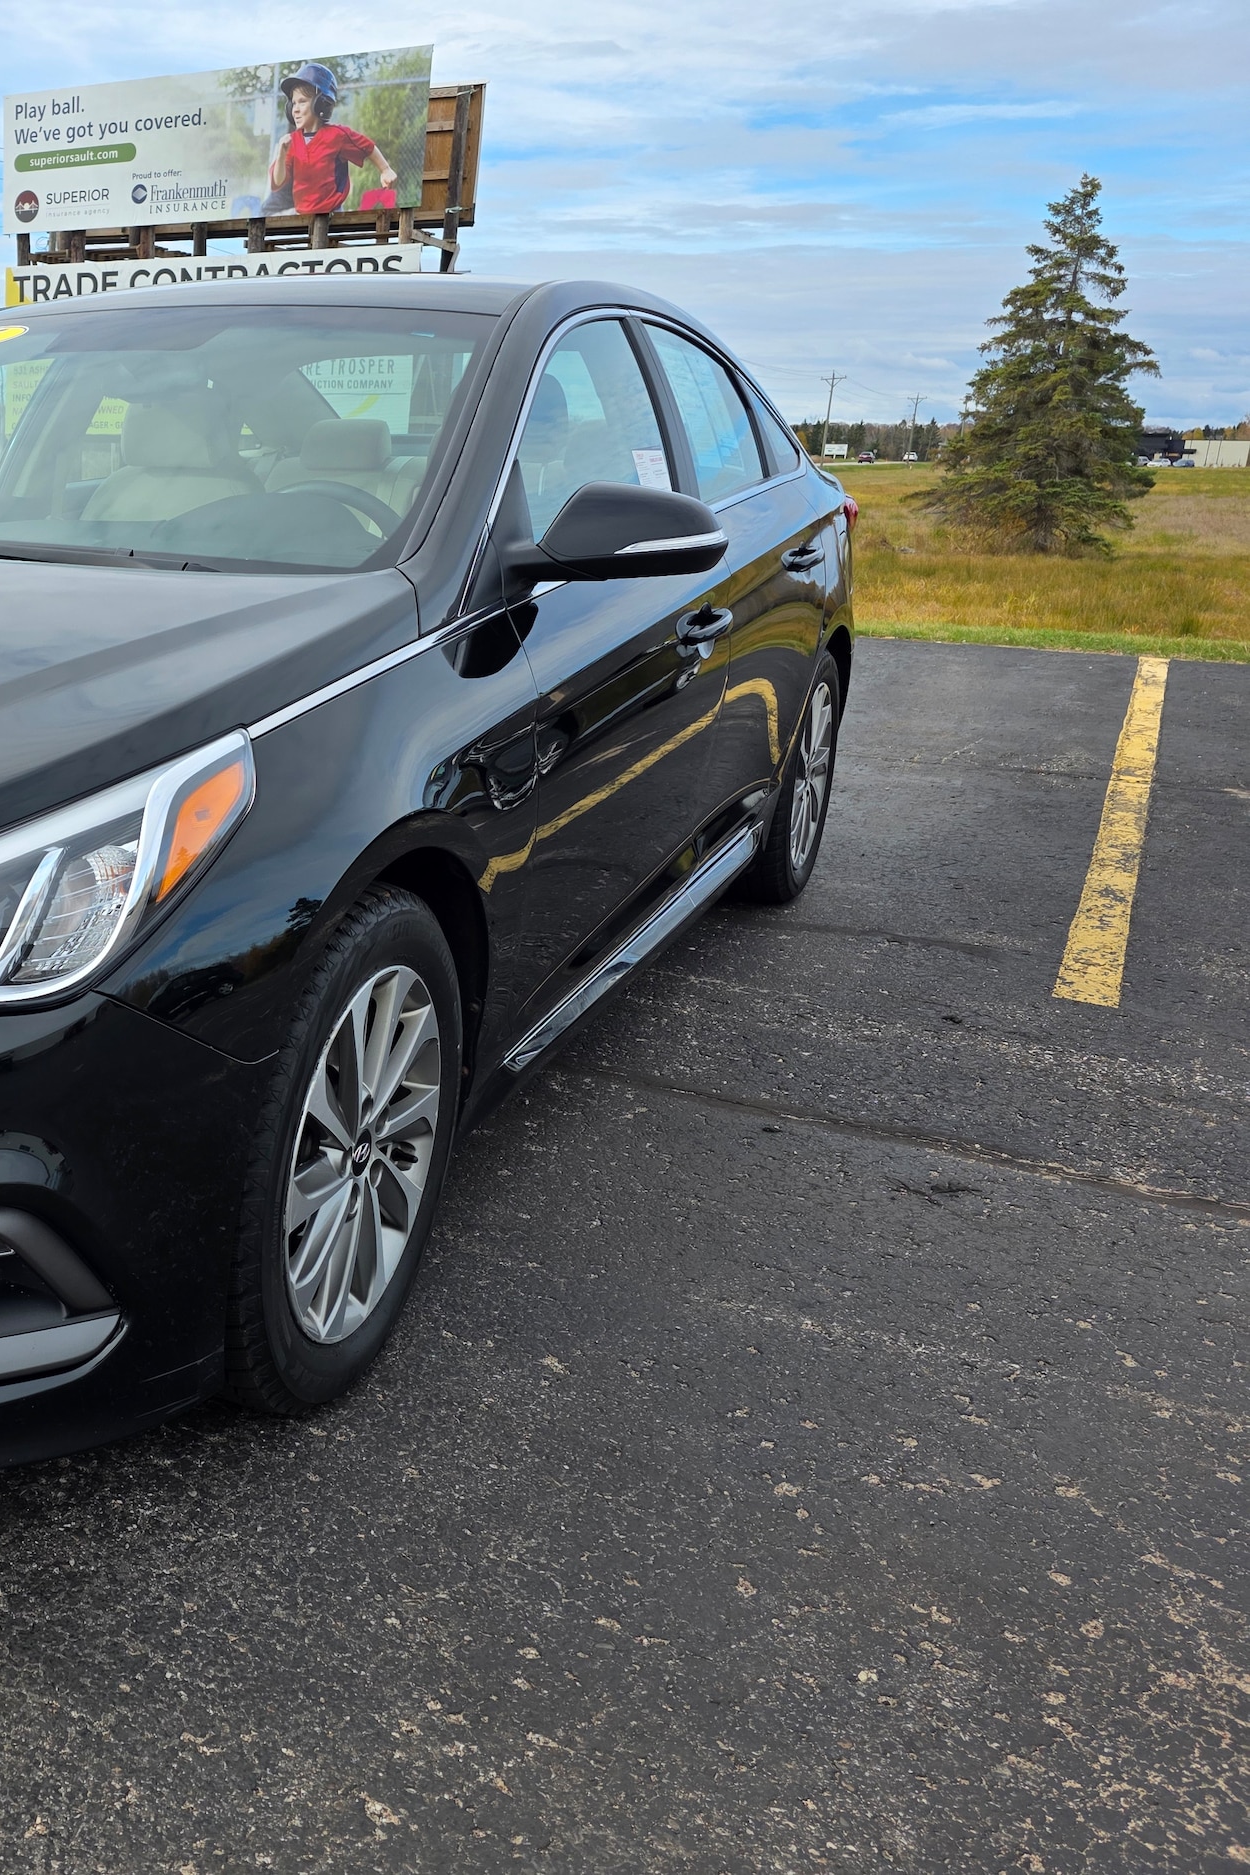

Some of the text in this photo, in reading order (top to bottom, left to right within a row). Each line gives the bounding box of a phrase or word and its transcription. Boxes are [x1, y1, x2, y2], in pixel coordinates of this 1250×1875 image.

[14, 96, 85, 122] Play ball.
[14, 107, 207, 145] We've got you covered.
[29, 149, 119, 169] superiorsault.com
[131, 169, 183, 181] Proud to offer:
[45, 188, 110, 205] SUPERIOR
[150, 179, 226, 201] Frankenmuth
[45, 207, 110, 218] insurance agency
[149, 200, 226, 214] INSURANCE
[330, 358, 395, 376] TROSPER
[347, 379, 394, 389] COMPANY
